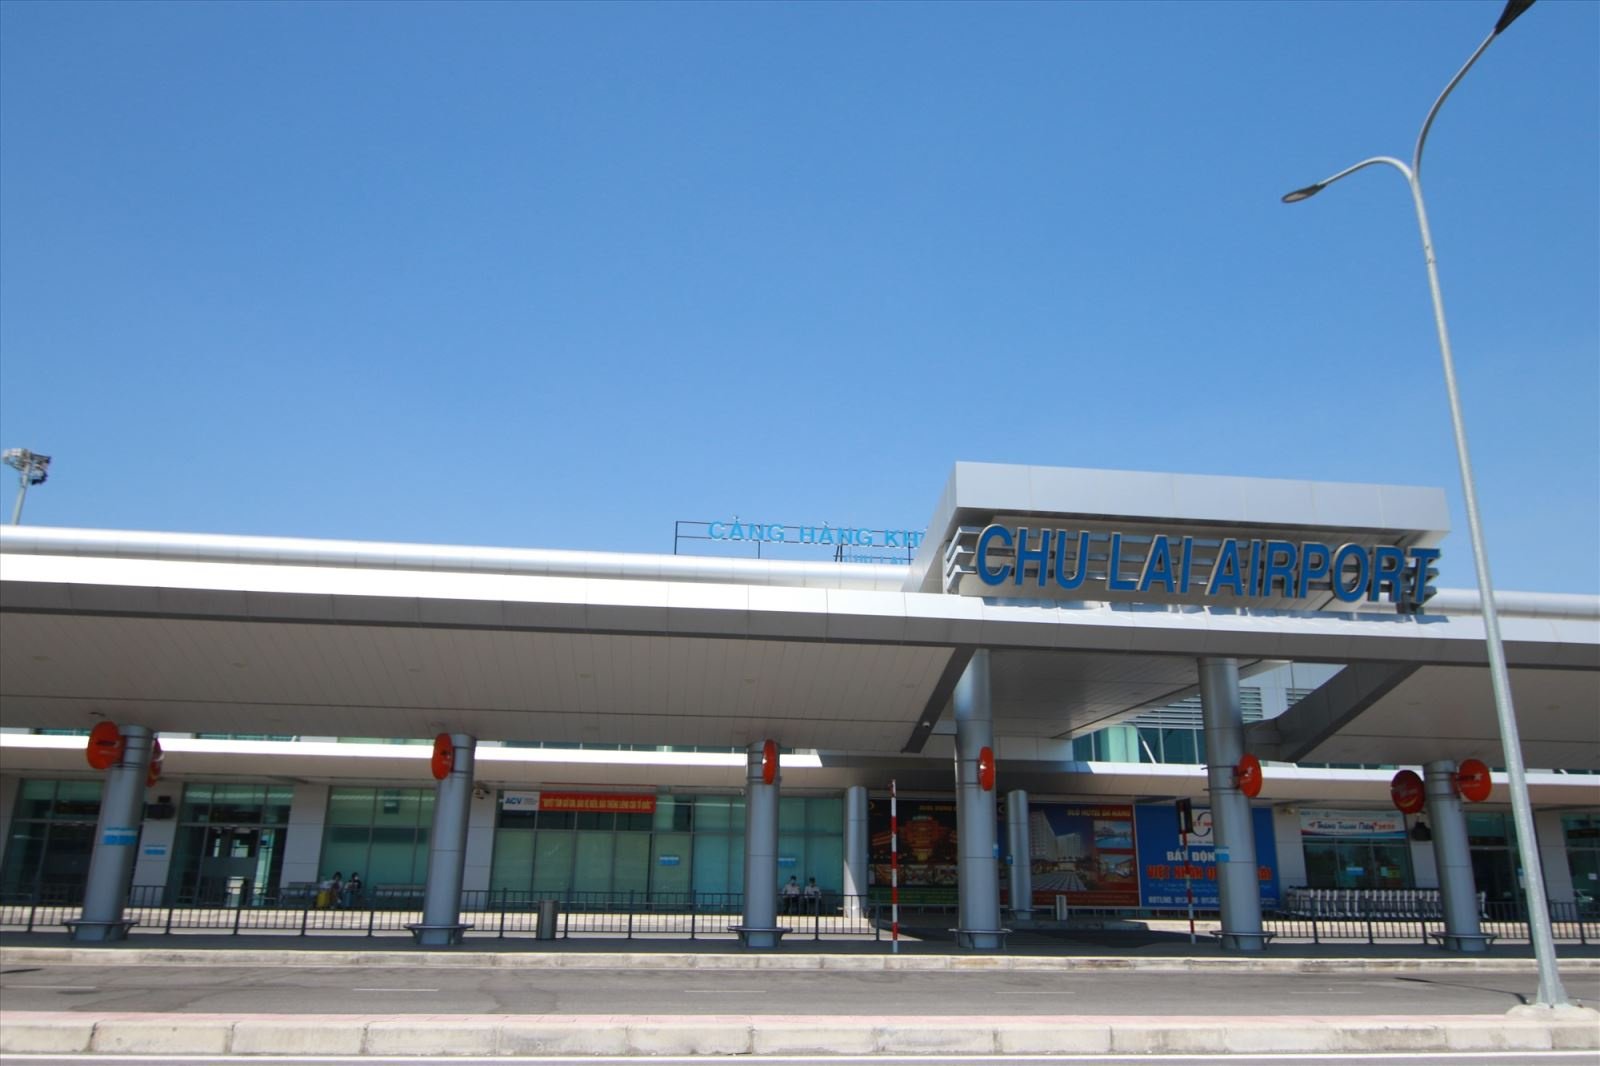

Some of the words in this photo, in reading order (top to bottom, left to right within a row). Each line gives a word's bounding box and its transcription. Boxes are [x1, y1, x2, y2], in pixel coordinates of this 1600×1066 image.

[708, 516, 785, 543] CẢNG
[799, 521, 873, 547] HÀNG
[884, 528, 927, 549] KH
[975, 523, 1089, 592] CHU
[1106, 531, 1193, 595] LAI
[1204, 536, 1441, 603] AIRPORT
